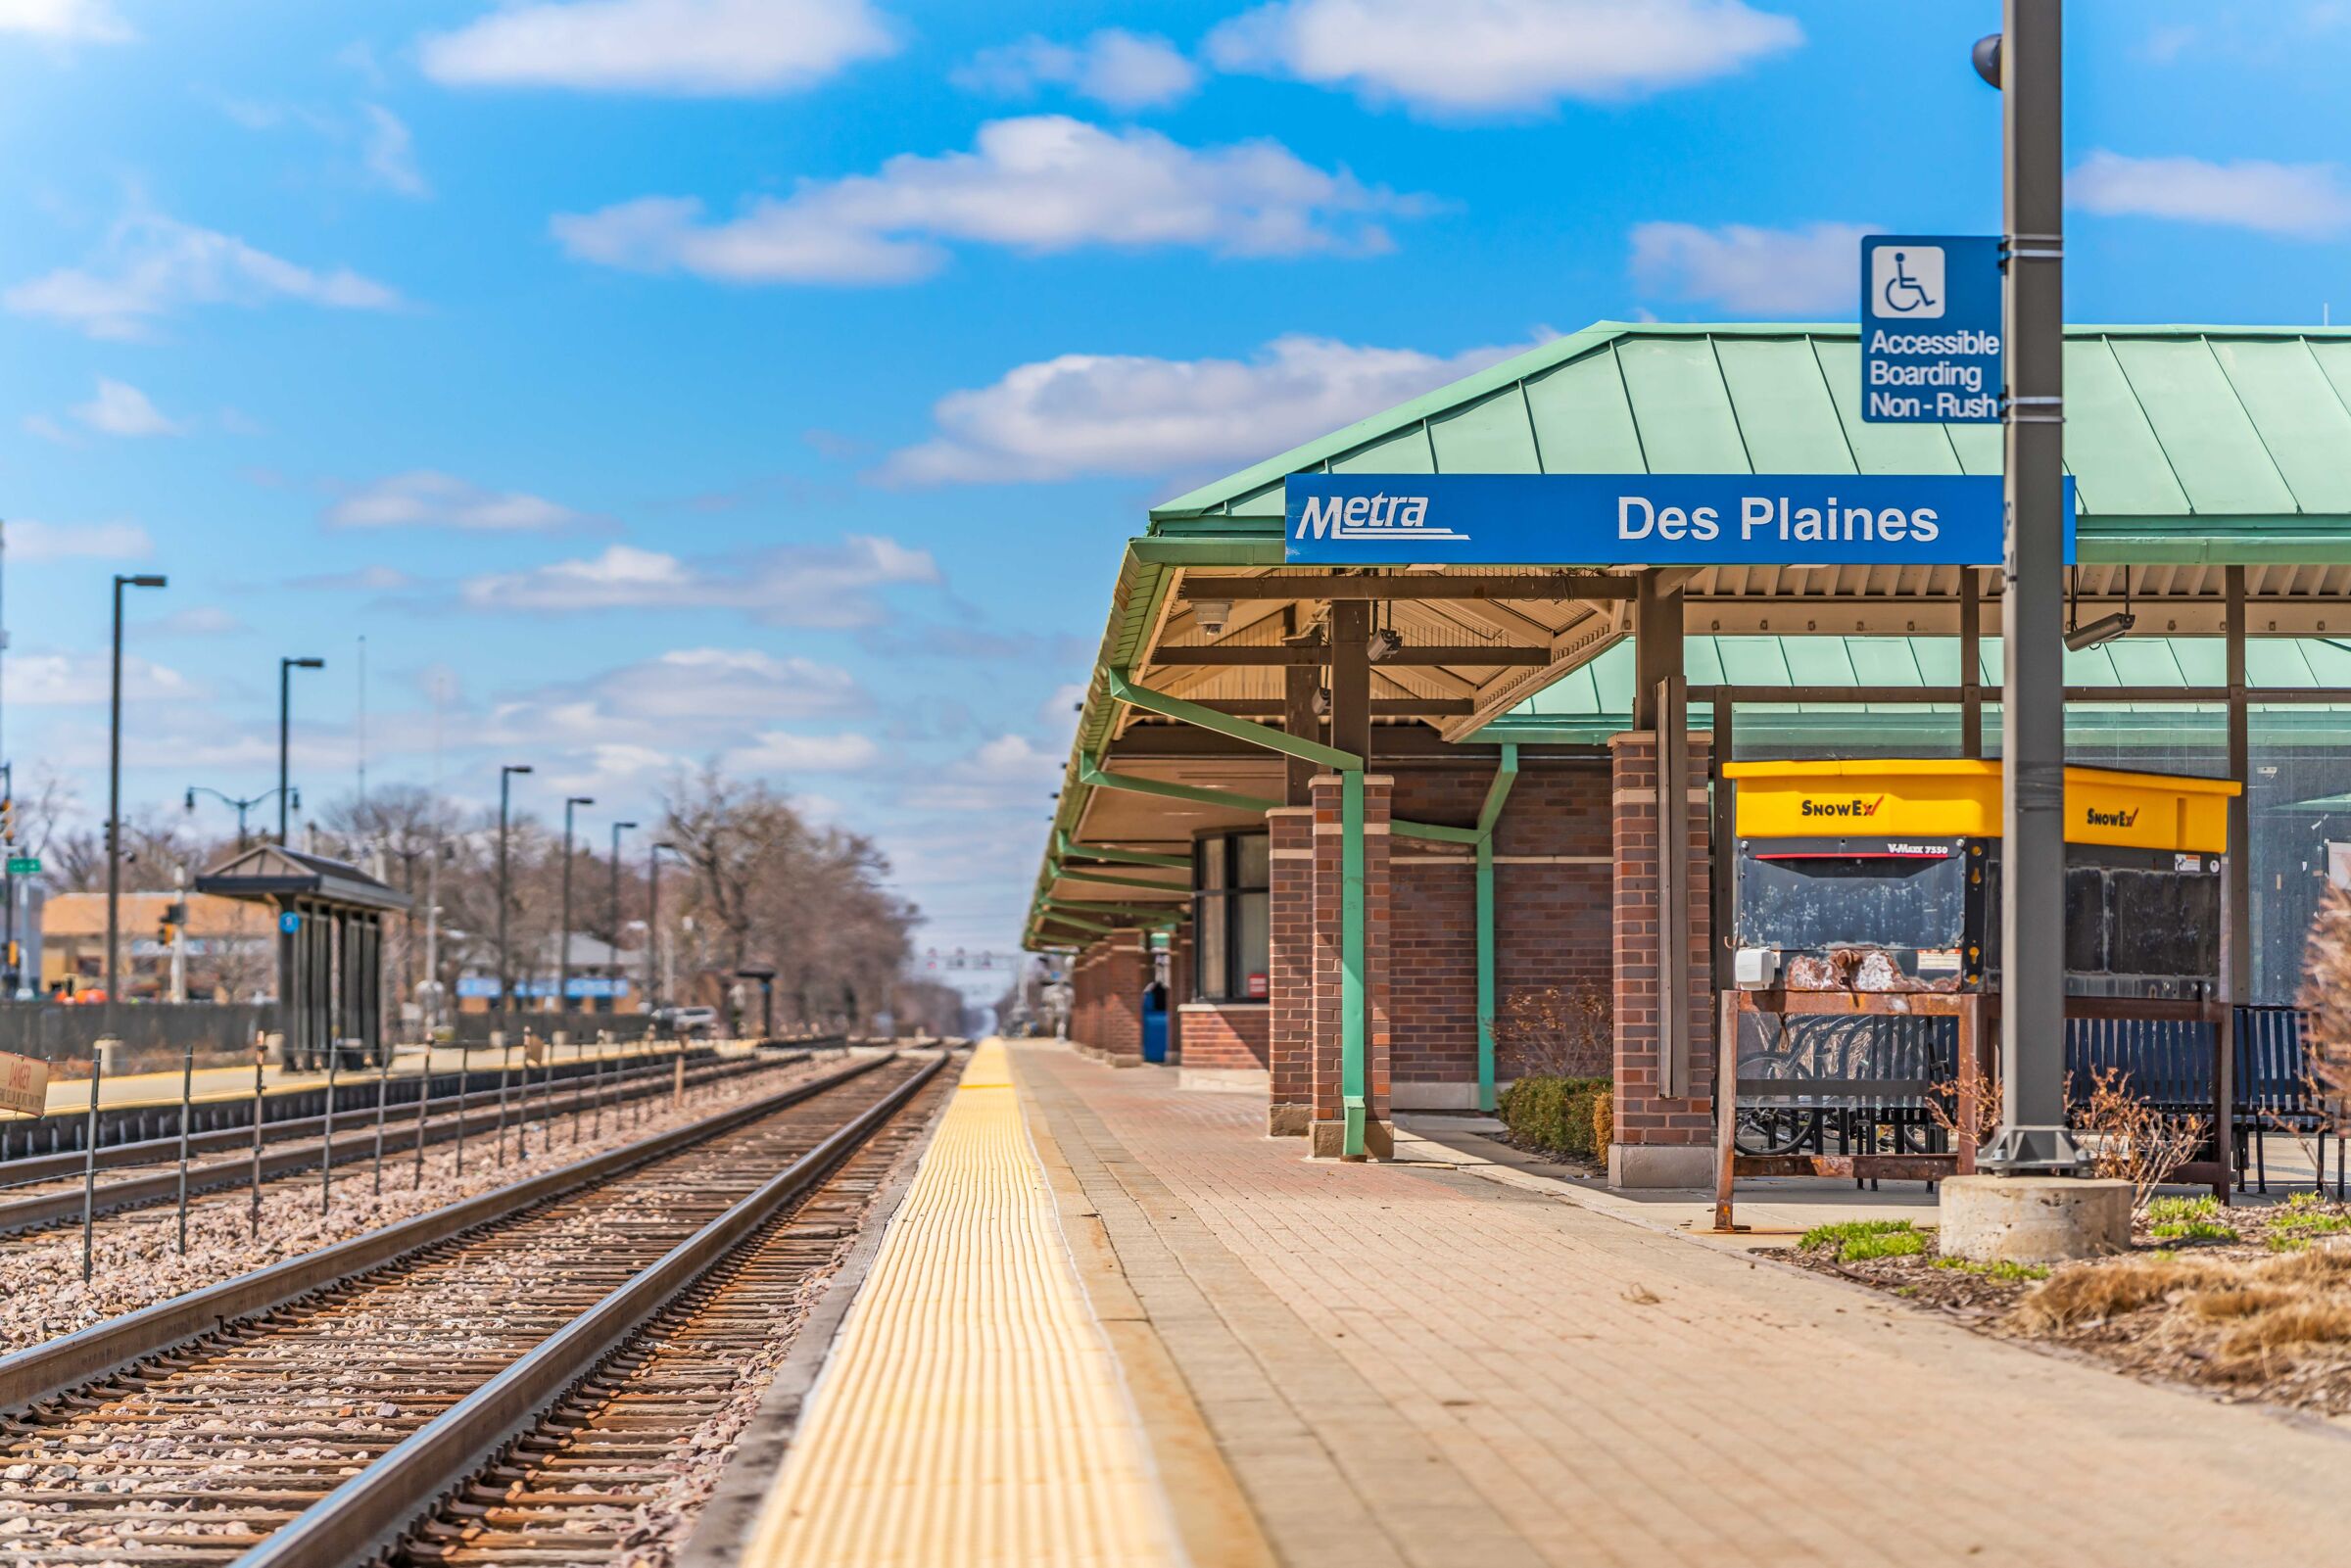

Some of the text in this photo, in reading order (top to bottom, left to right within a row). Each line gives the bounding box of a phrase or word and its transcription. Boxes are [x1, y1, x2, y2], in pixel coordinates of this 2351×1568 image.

[1869, 329, 2000, 356] Accessible
[1870, 360, 1982, 393] Boarding
[1295, 492, 1429, 540] Metra
[1618, 497, 1940, 542] Des Plaines
